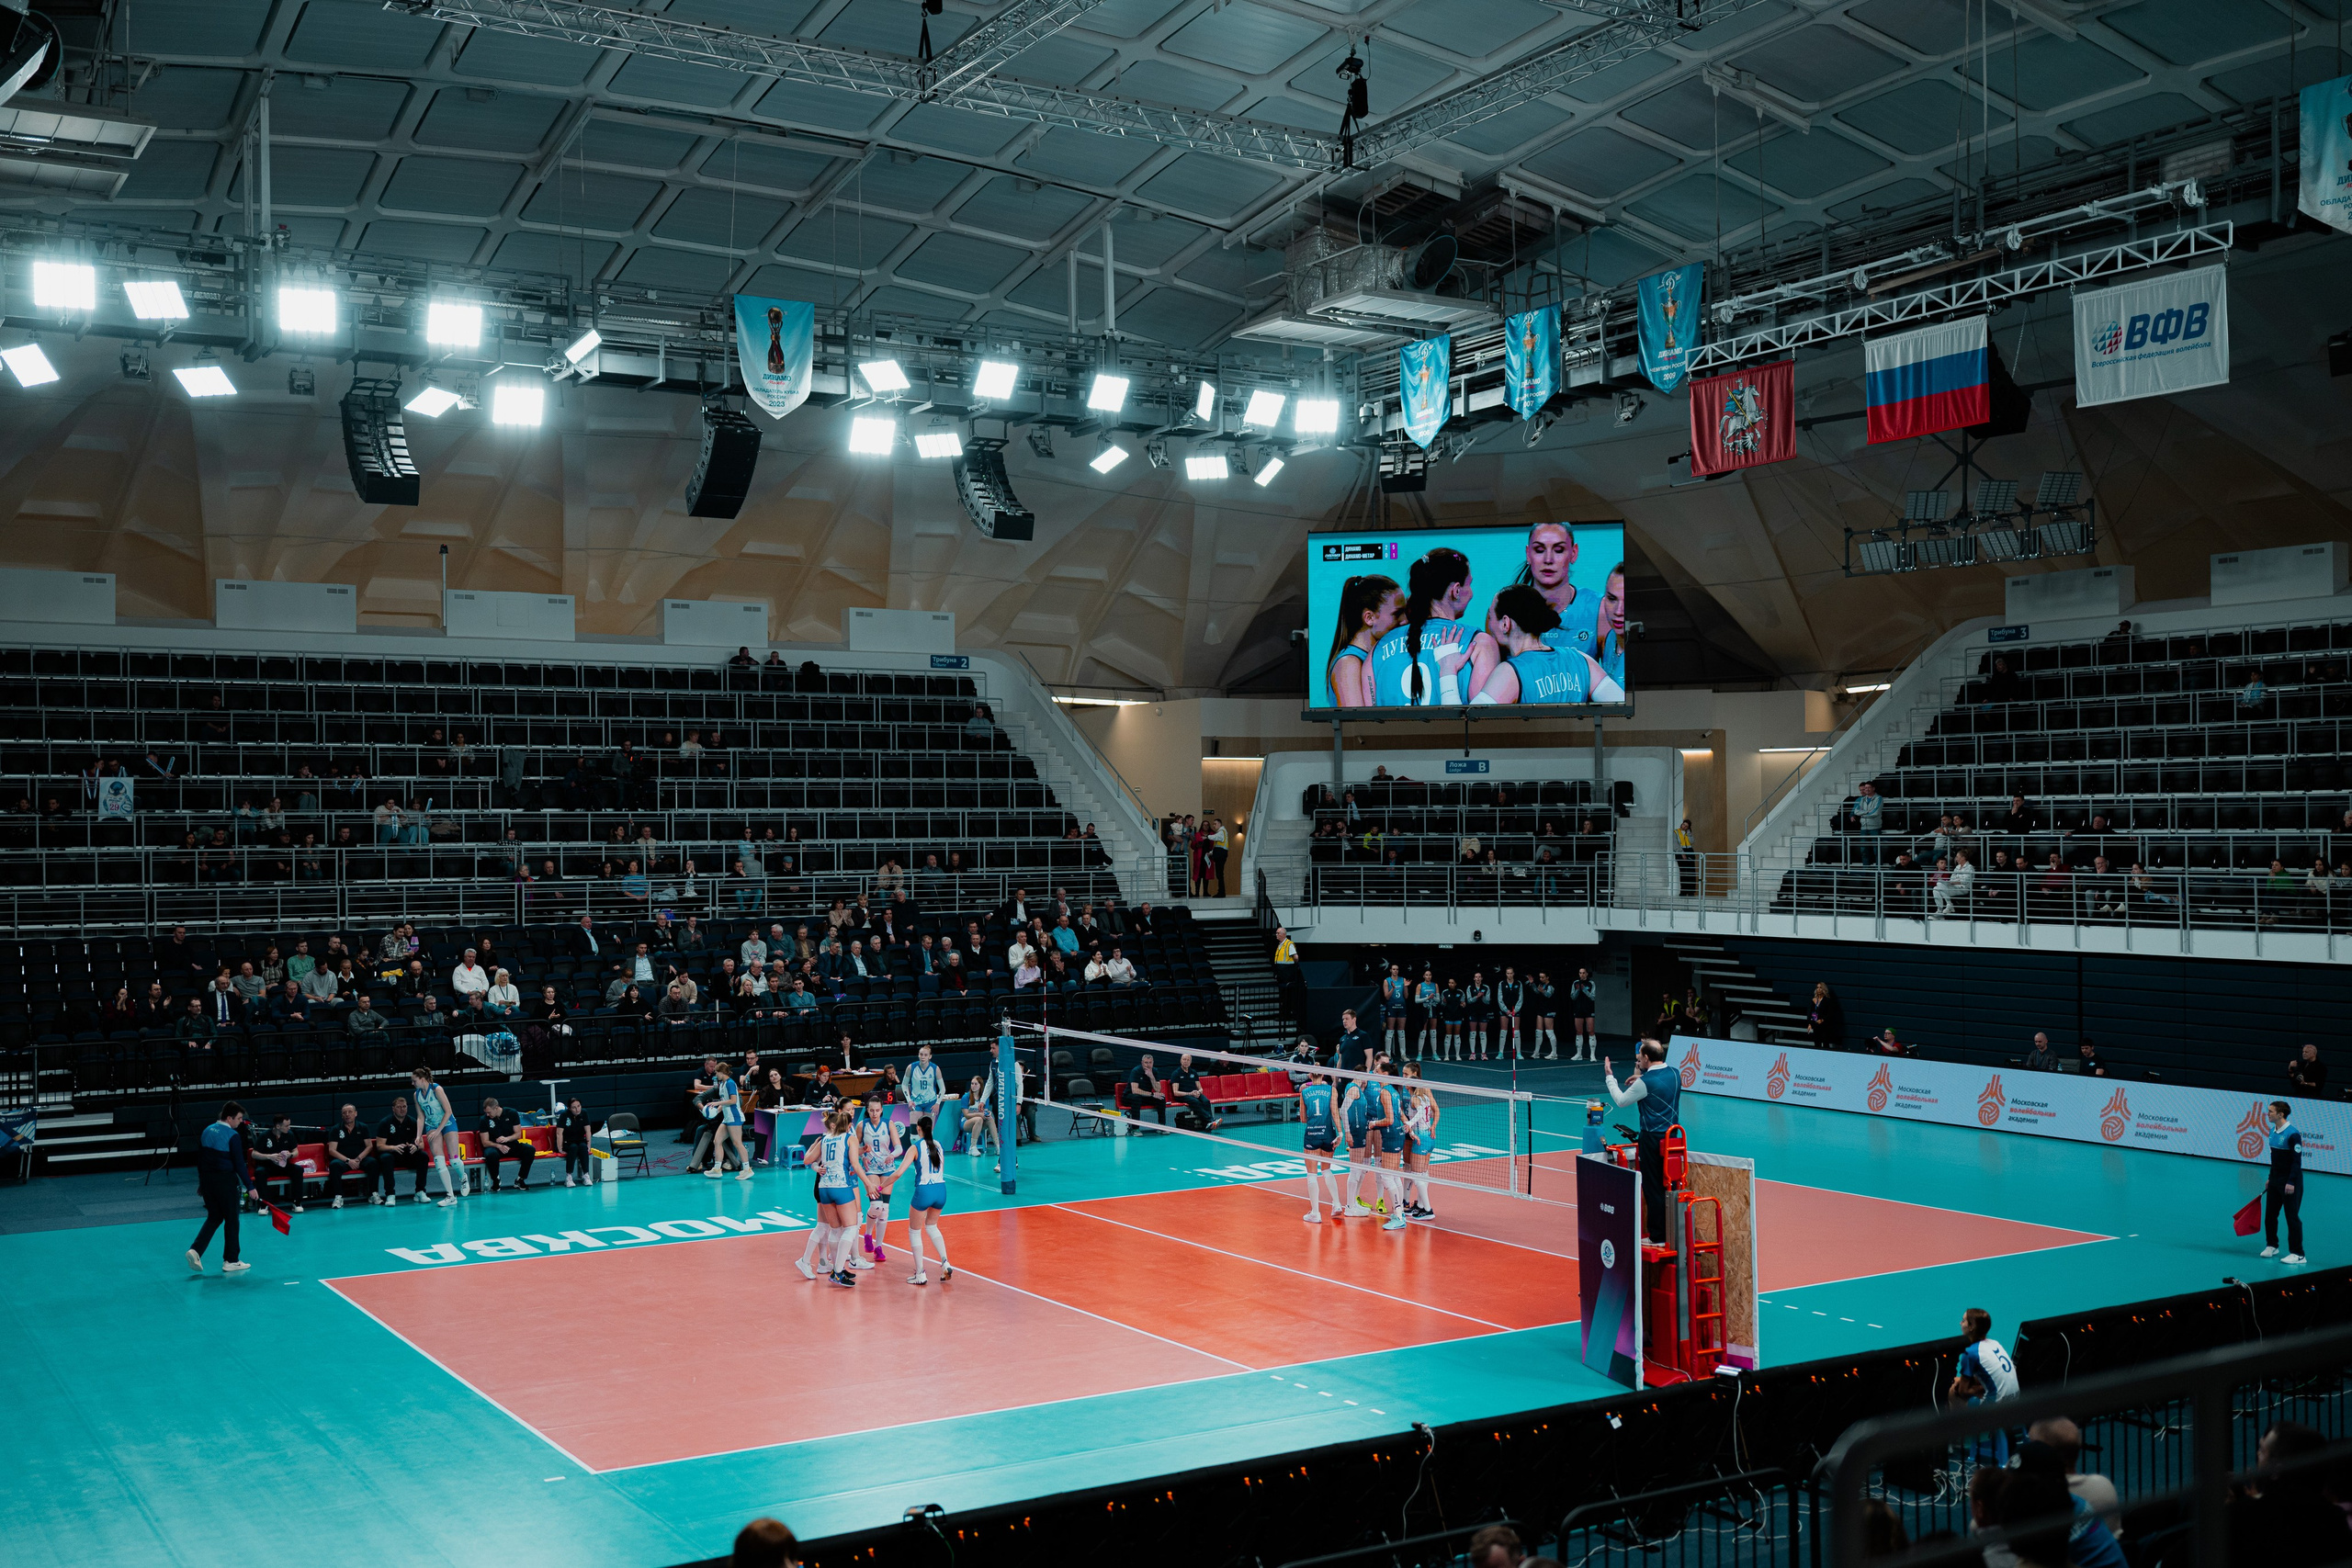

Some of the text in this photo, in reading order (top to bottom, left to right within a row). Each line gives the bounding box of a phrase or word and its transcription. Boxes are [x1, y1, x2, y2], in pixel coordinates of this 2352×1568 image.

[2320, 195, 2352, 207] ОБЛАДА
[2124, 301, 2210, 350] ВФВ
[1657, 347, 1683, 359] ДИНАМО
[2091, 342, 2211, 368] Всероссийская федерация волейбола
[763, 373, 792, 381] ДИНАМО
[1664, 372, 1676, 380] 2009
[1990, 627, 2027, 637] Трибуна 3
[961, 659, 967, 668] 2
[1535, 672, 1582, 699] ПОПОВА
[109, 803, 119, 811] 29
[1395, 989, 1401, 998] 5
[1705, 1064, 1733, 1072] Московская
[1703, 1071, 1738, 1080] волейбольная
[1794, 1074, 1826, 1082] Московская
[1792, 1082, 1832, 1091] волейбольная
[1897, 1086, 1931, 1095] Московская
[887, 1091, 893, 1101] 6
[1896, 1094, 1939, 1103] волейбольная
[1312, 1098, 1322, 1116] 1
[1894, 1101, 1922, 1110] академия
[2010, 1098, 2048, 1109] Московская
[424, 1105, 434, 1115] 12
[2009, 1107, 2056, 1118] волейбольная
[2007, 1115, 2038, 1124] академия
[2137, 1112, 2178, 1123] Московская
[2136, 1122, 2188, 1134] волейбольная
[2134, 1131, 2167, 1140] академия
[873, 1139, 880, 1153] 9
[826, 1142, 837, 1162] 16
[384, 1211, 811, 1265] МОСКВА
[1993, 1347, 2012, 1373] 5
